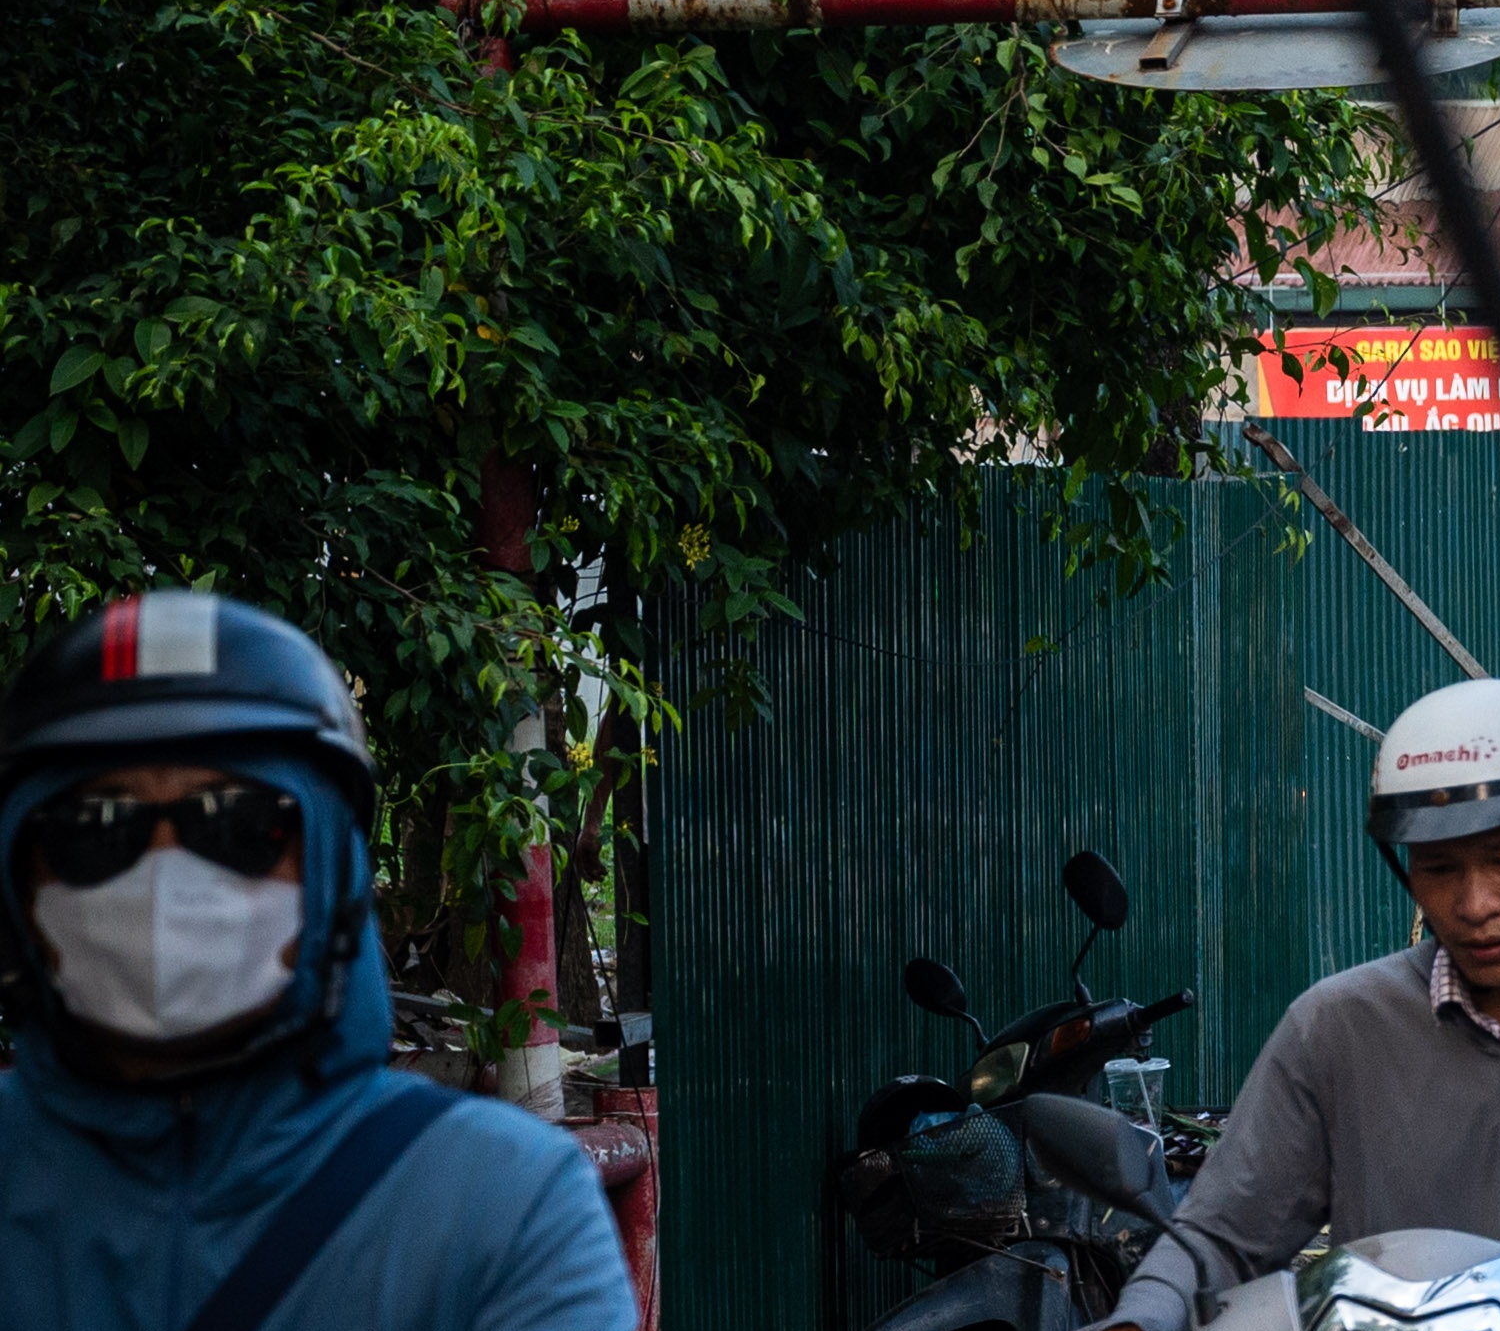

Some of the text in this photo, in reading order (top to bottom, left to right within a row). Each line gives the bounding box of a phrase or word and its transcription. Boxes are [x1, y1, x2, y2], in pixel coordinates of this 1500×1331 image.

[1355, 336, 1500, 363] GARA SAO VIỆ
[1326, 378, 1387, 405] DỊCH
[1394, 378, 1428, 406] VỤ
[1436, 373, 1490, 400] LÀM
